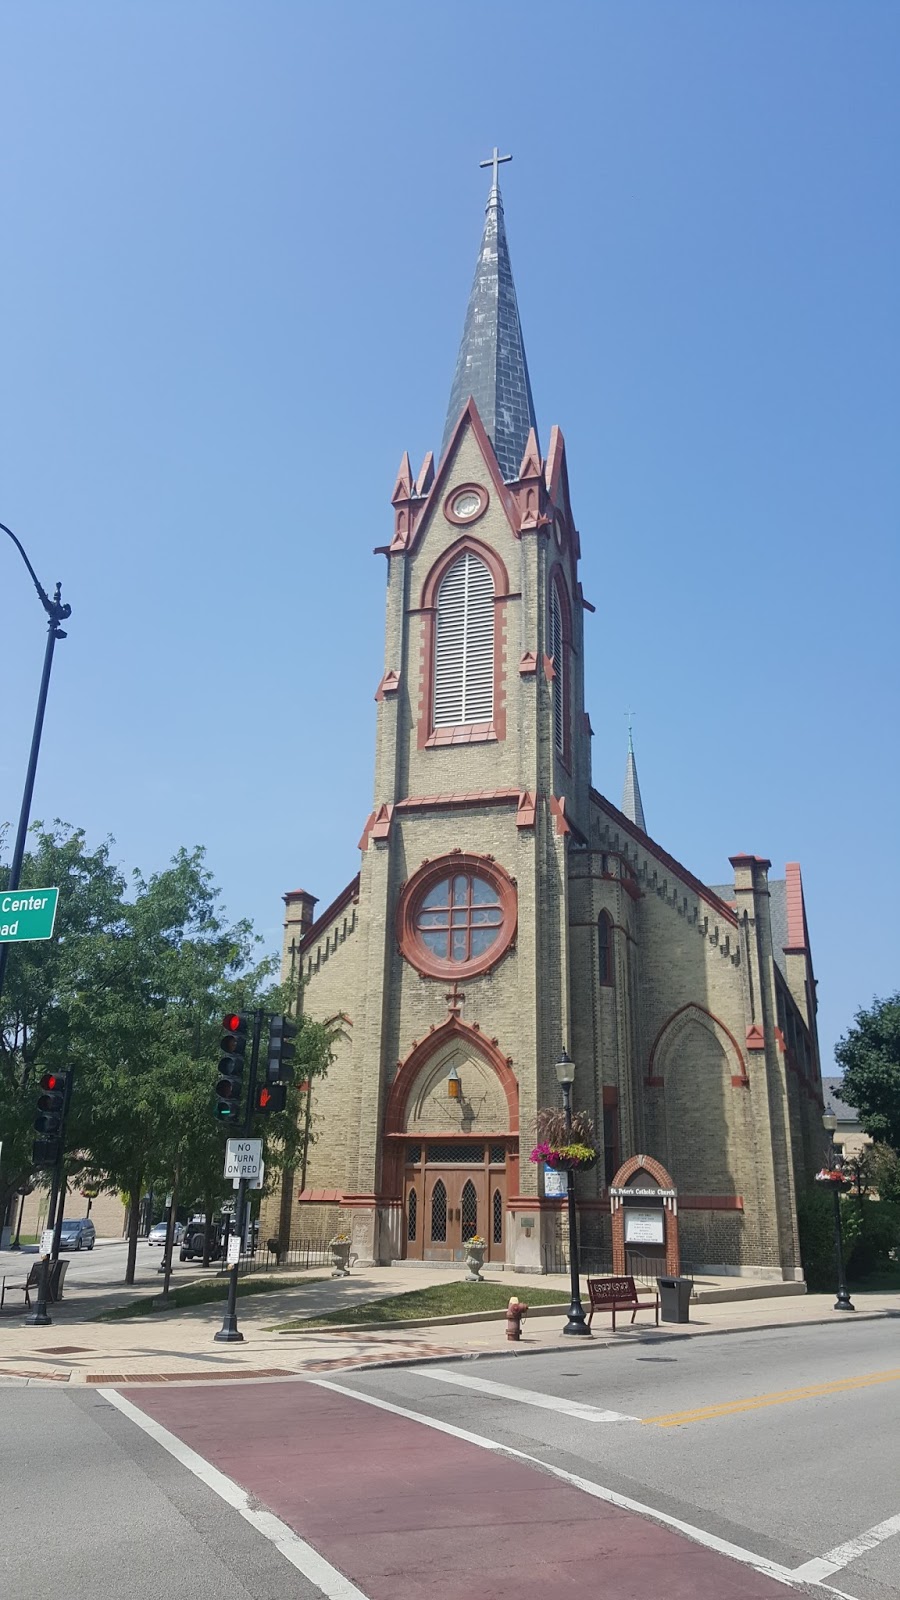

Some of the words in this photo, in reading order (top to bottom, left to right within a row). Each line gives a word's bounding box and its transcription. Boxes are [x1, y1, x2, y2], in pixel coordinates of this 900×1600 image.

[2, 896, 48, 912] Center
[0, 920, 19, 936] ad
[234, 1154, 254, 1162] TURN
[228, 1165, 239, 1173] ON
[242, 1165, 257, 1173] RED
